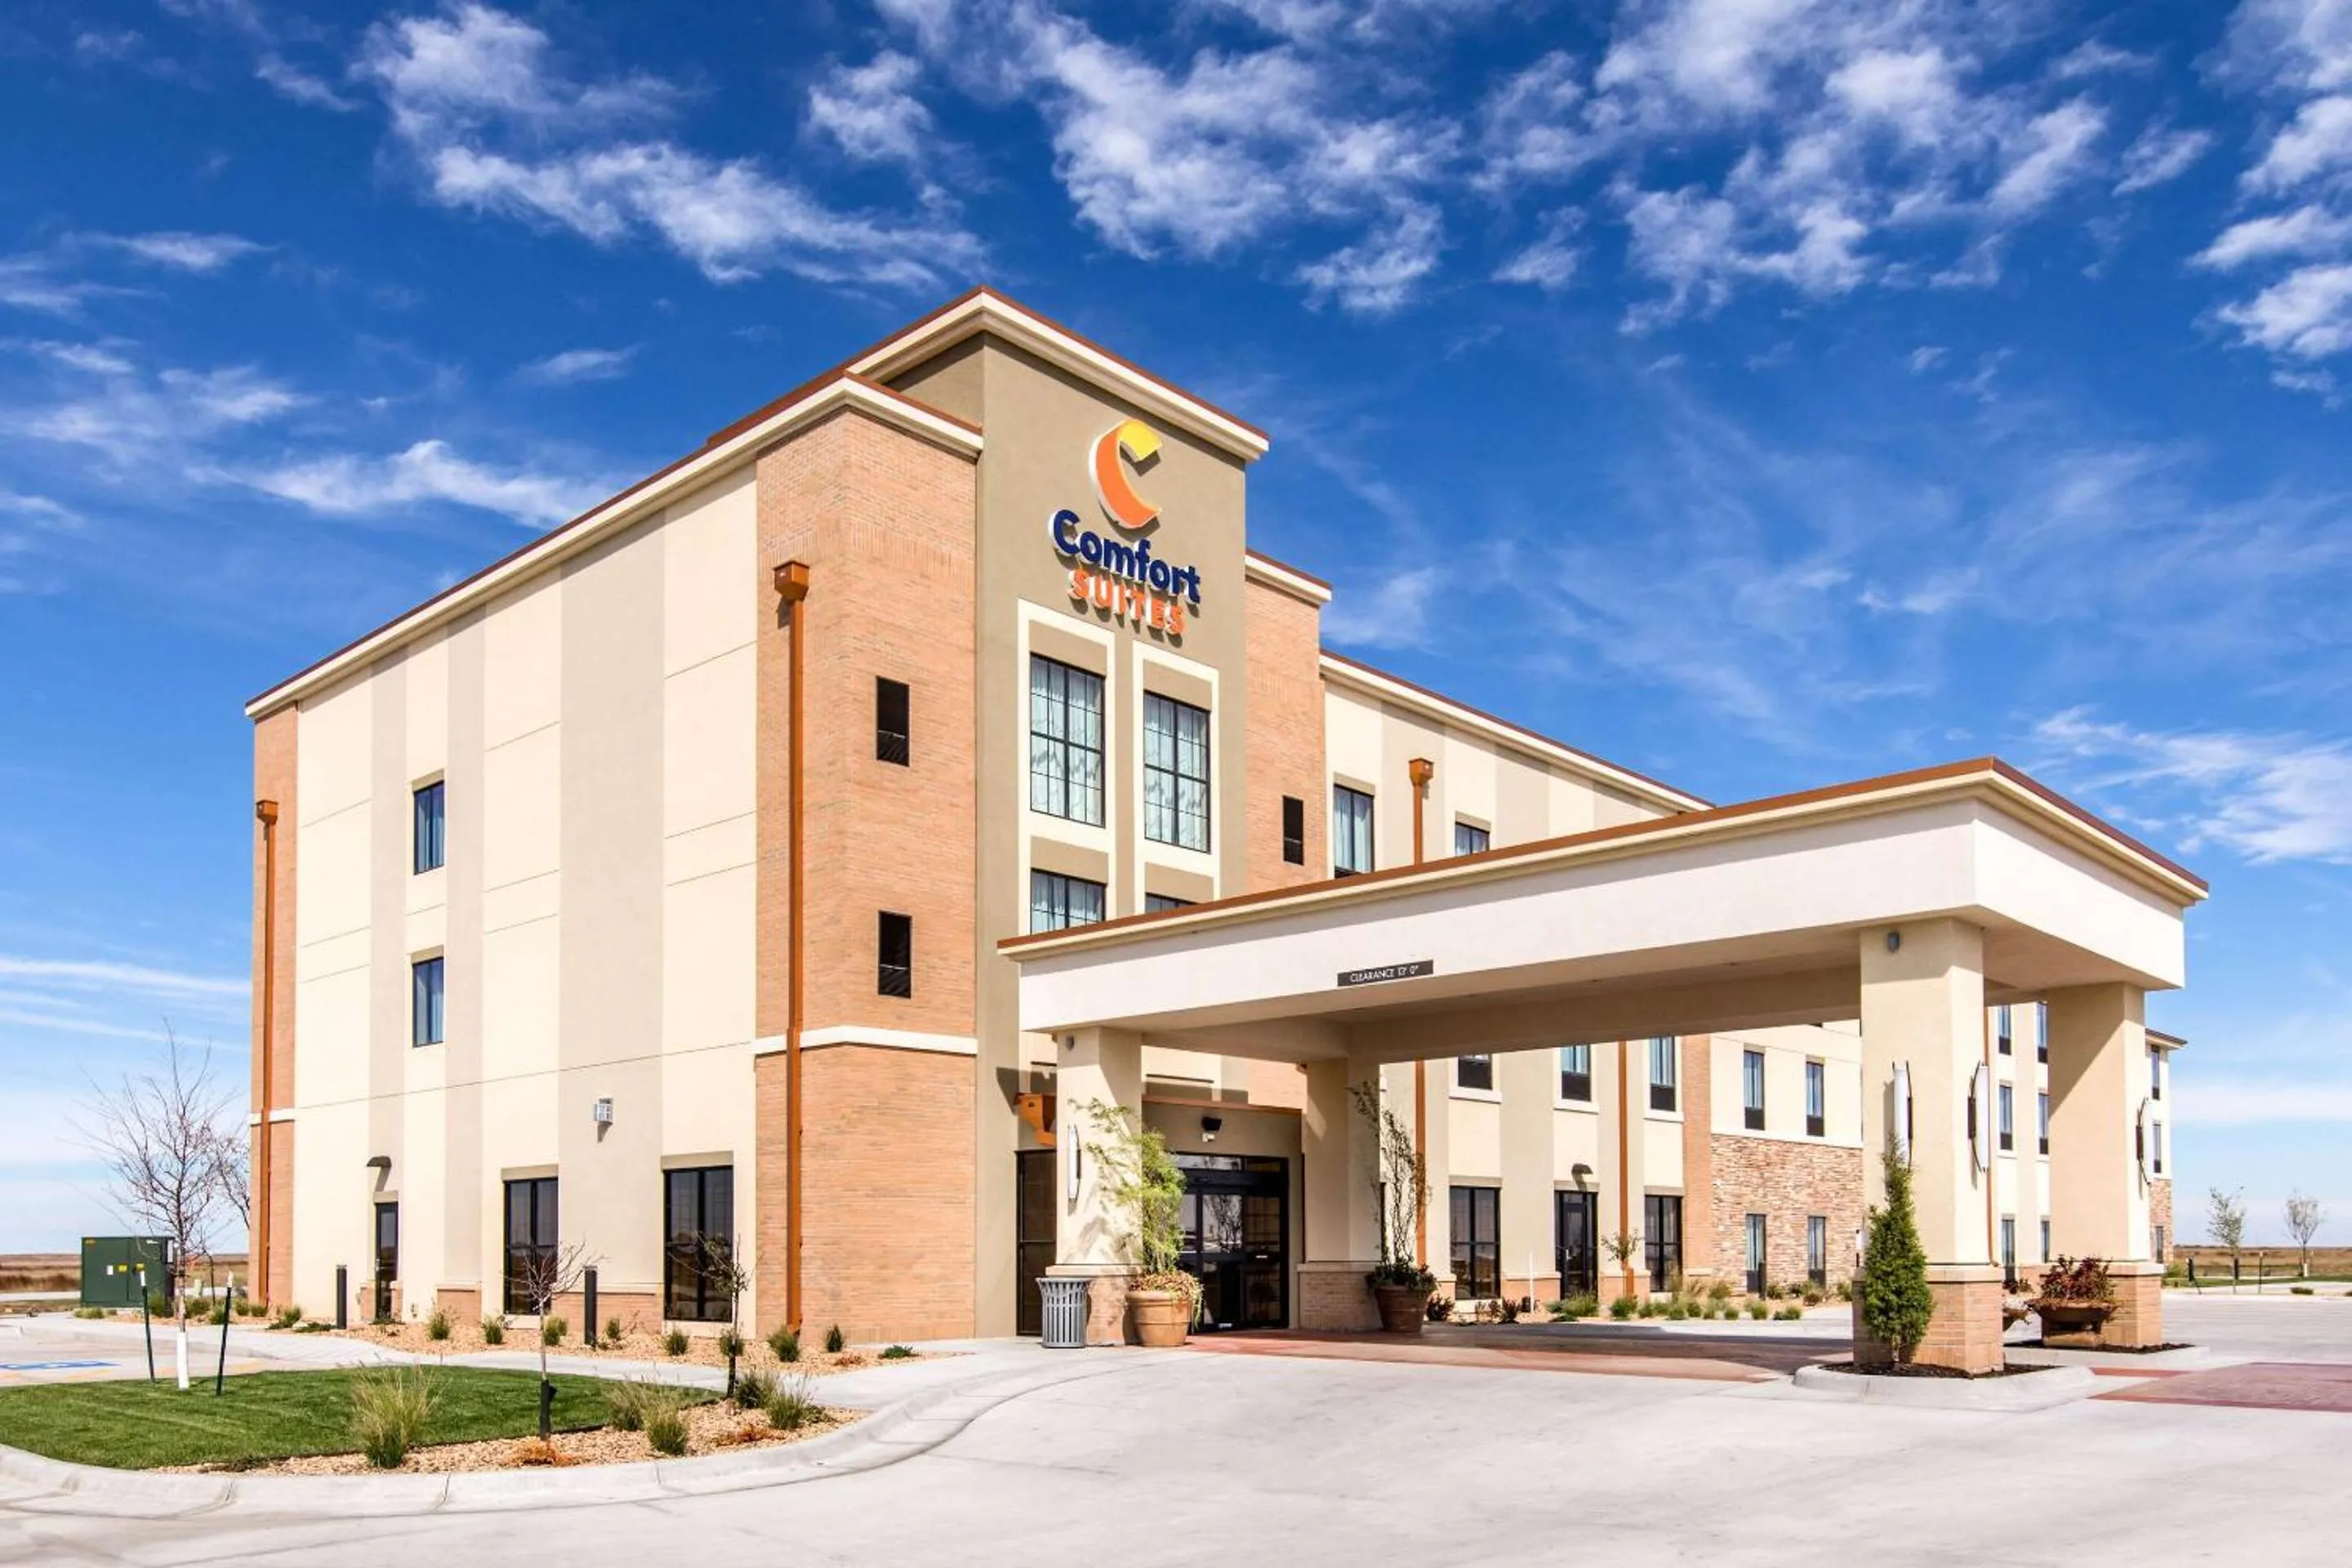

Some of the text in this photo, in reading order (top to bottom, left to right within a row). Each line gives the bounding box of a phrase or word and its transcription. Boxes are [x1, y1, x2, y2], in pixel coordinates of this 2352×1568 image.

[1048, 509, 1200, 604] Comfort
[1067, 568, 1186, 635] SUITES
[1350, 969, 1395, 982] CLEARANCE
